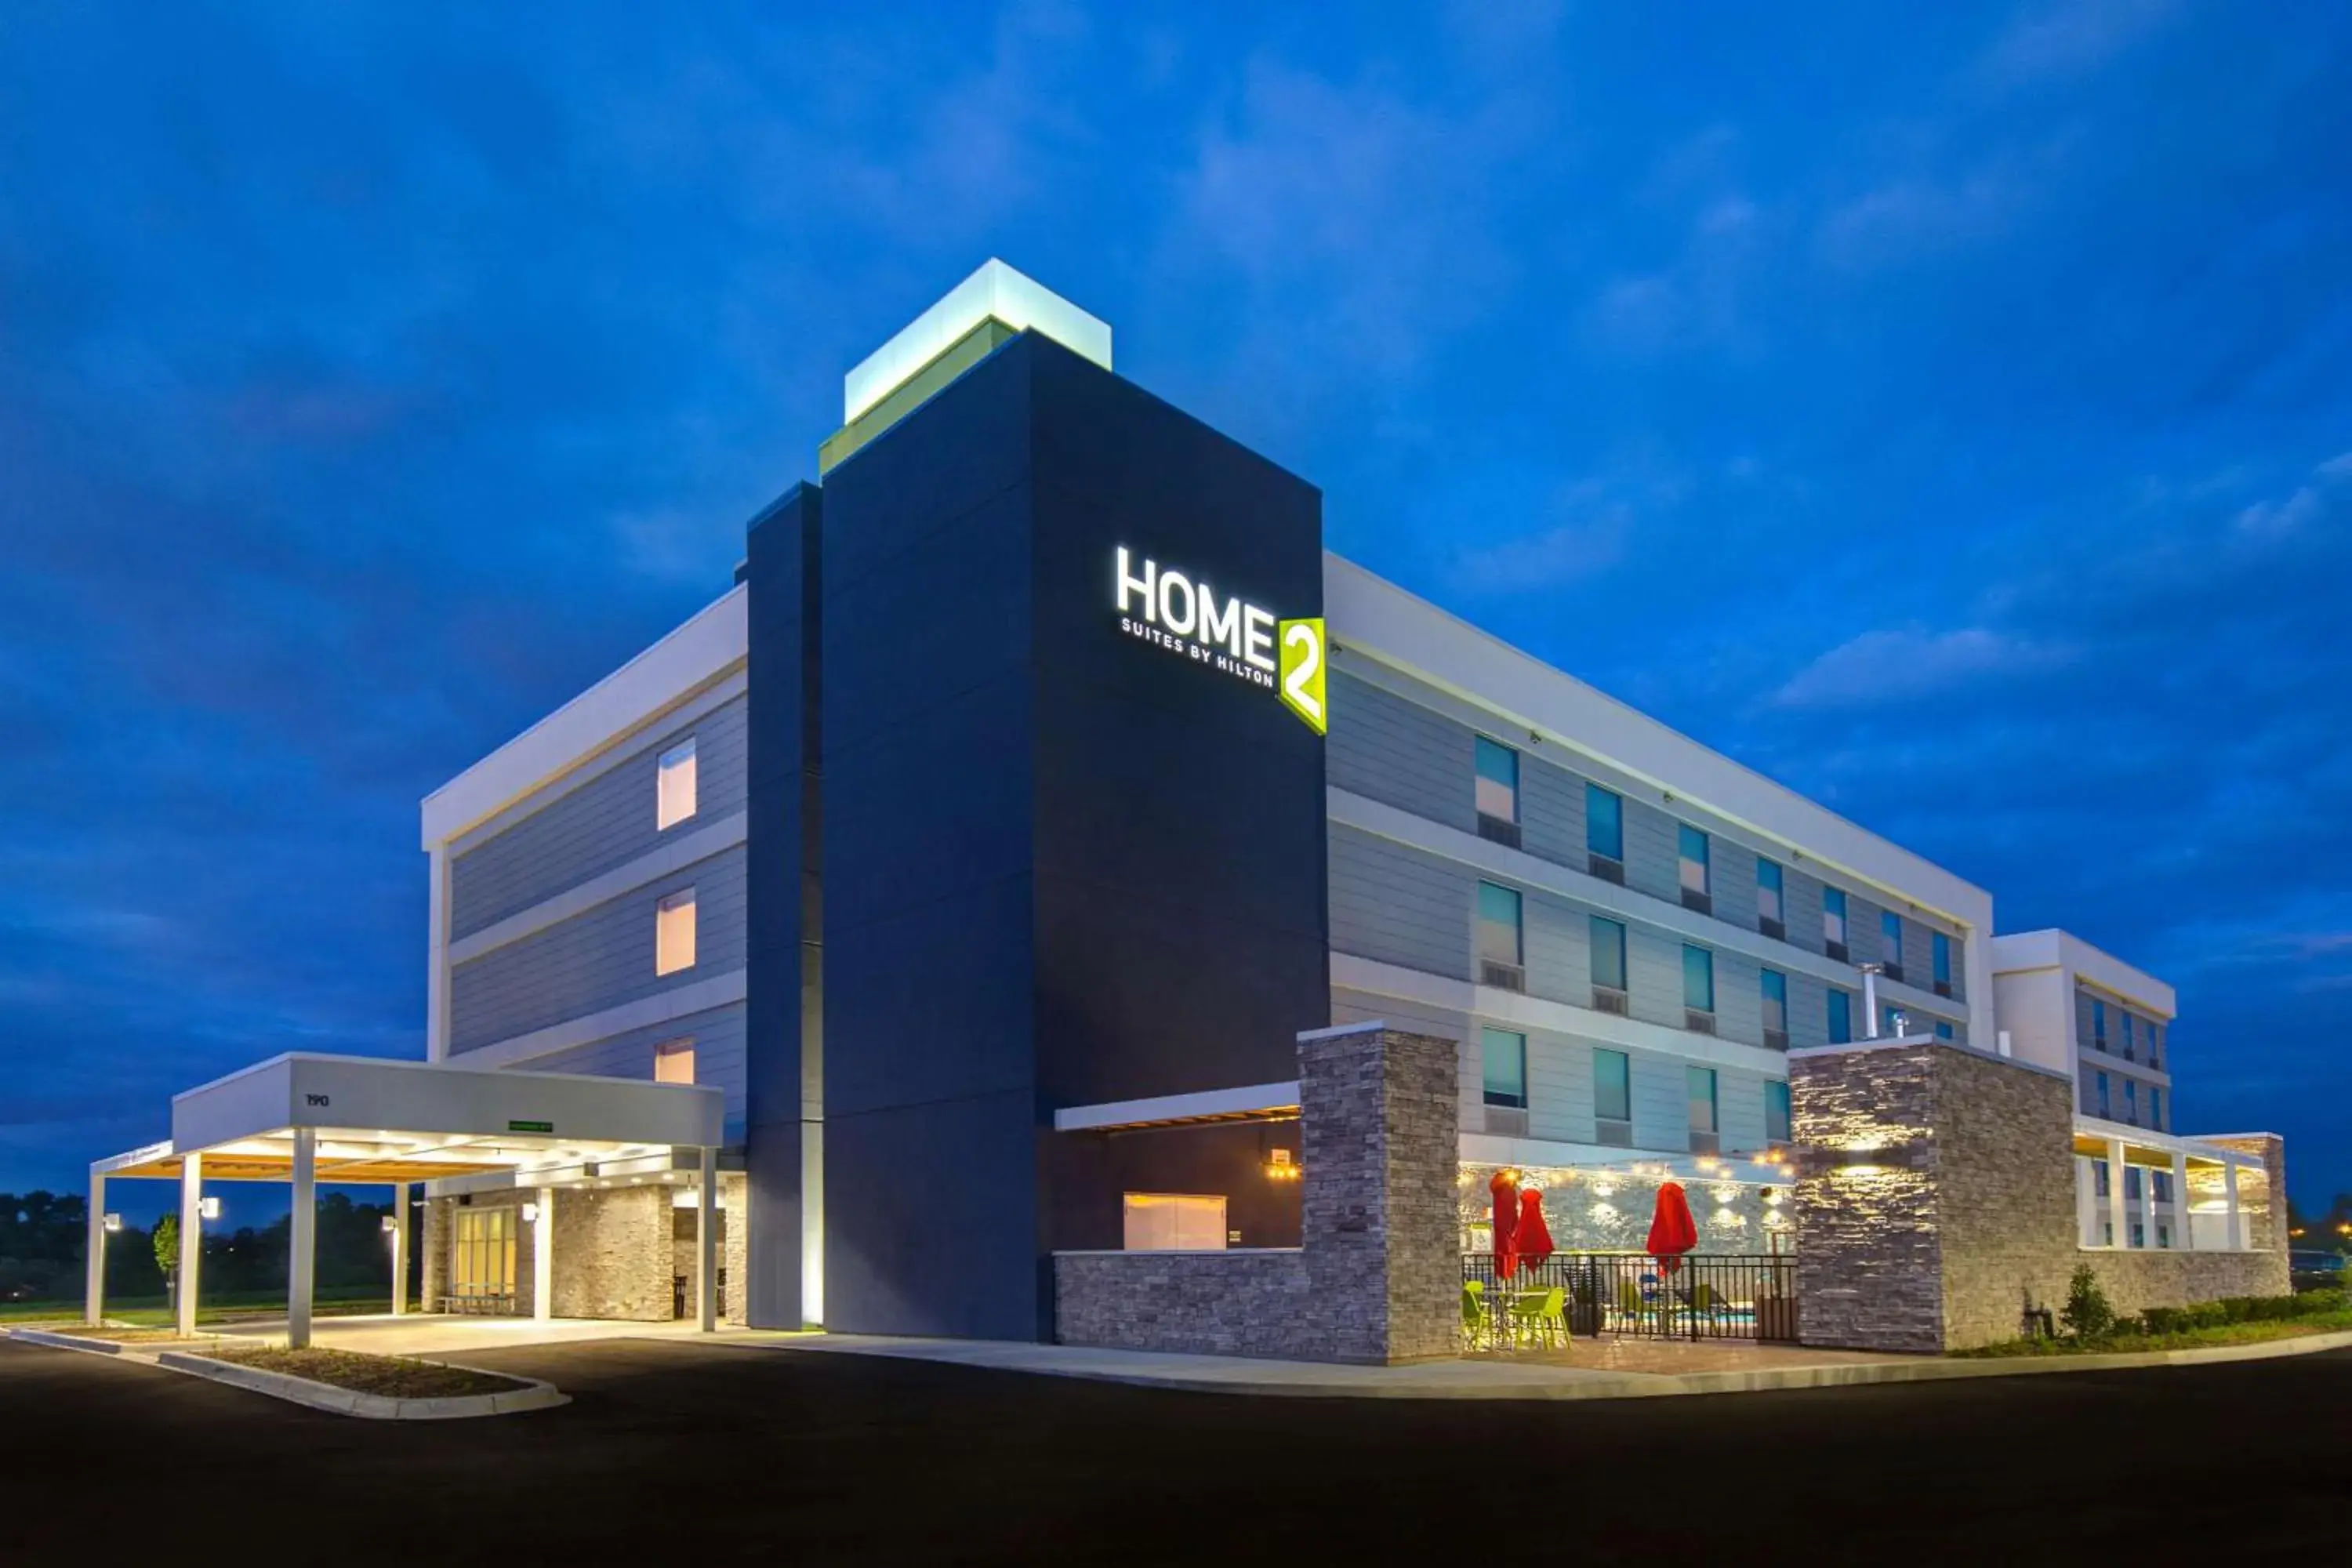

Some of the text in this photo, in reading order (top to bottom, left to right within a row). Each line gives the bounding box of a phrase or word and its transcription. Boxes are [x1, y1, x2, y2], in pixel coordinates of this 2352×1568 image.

[1116, 546, 1320, 718] HOME 2
[1122, 618, 1273, 688] SUITES BY HILTON
